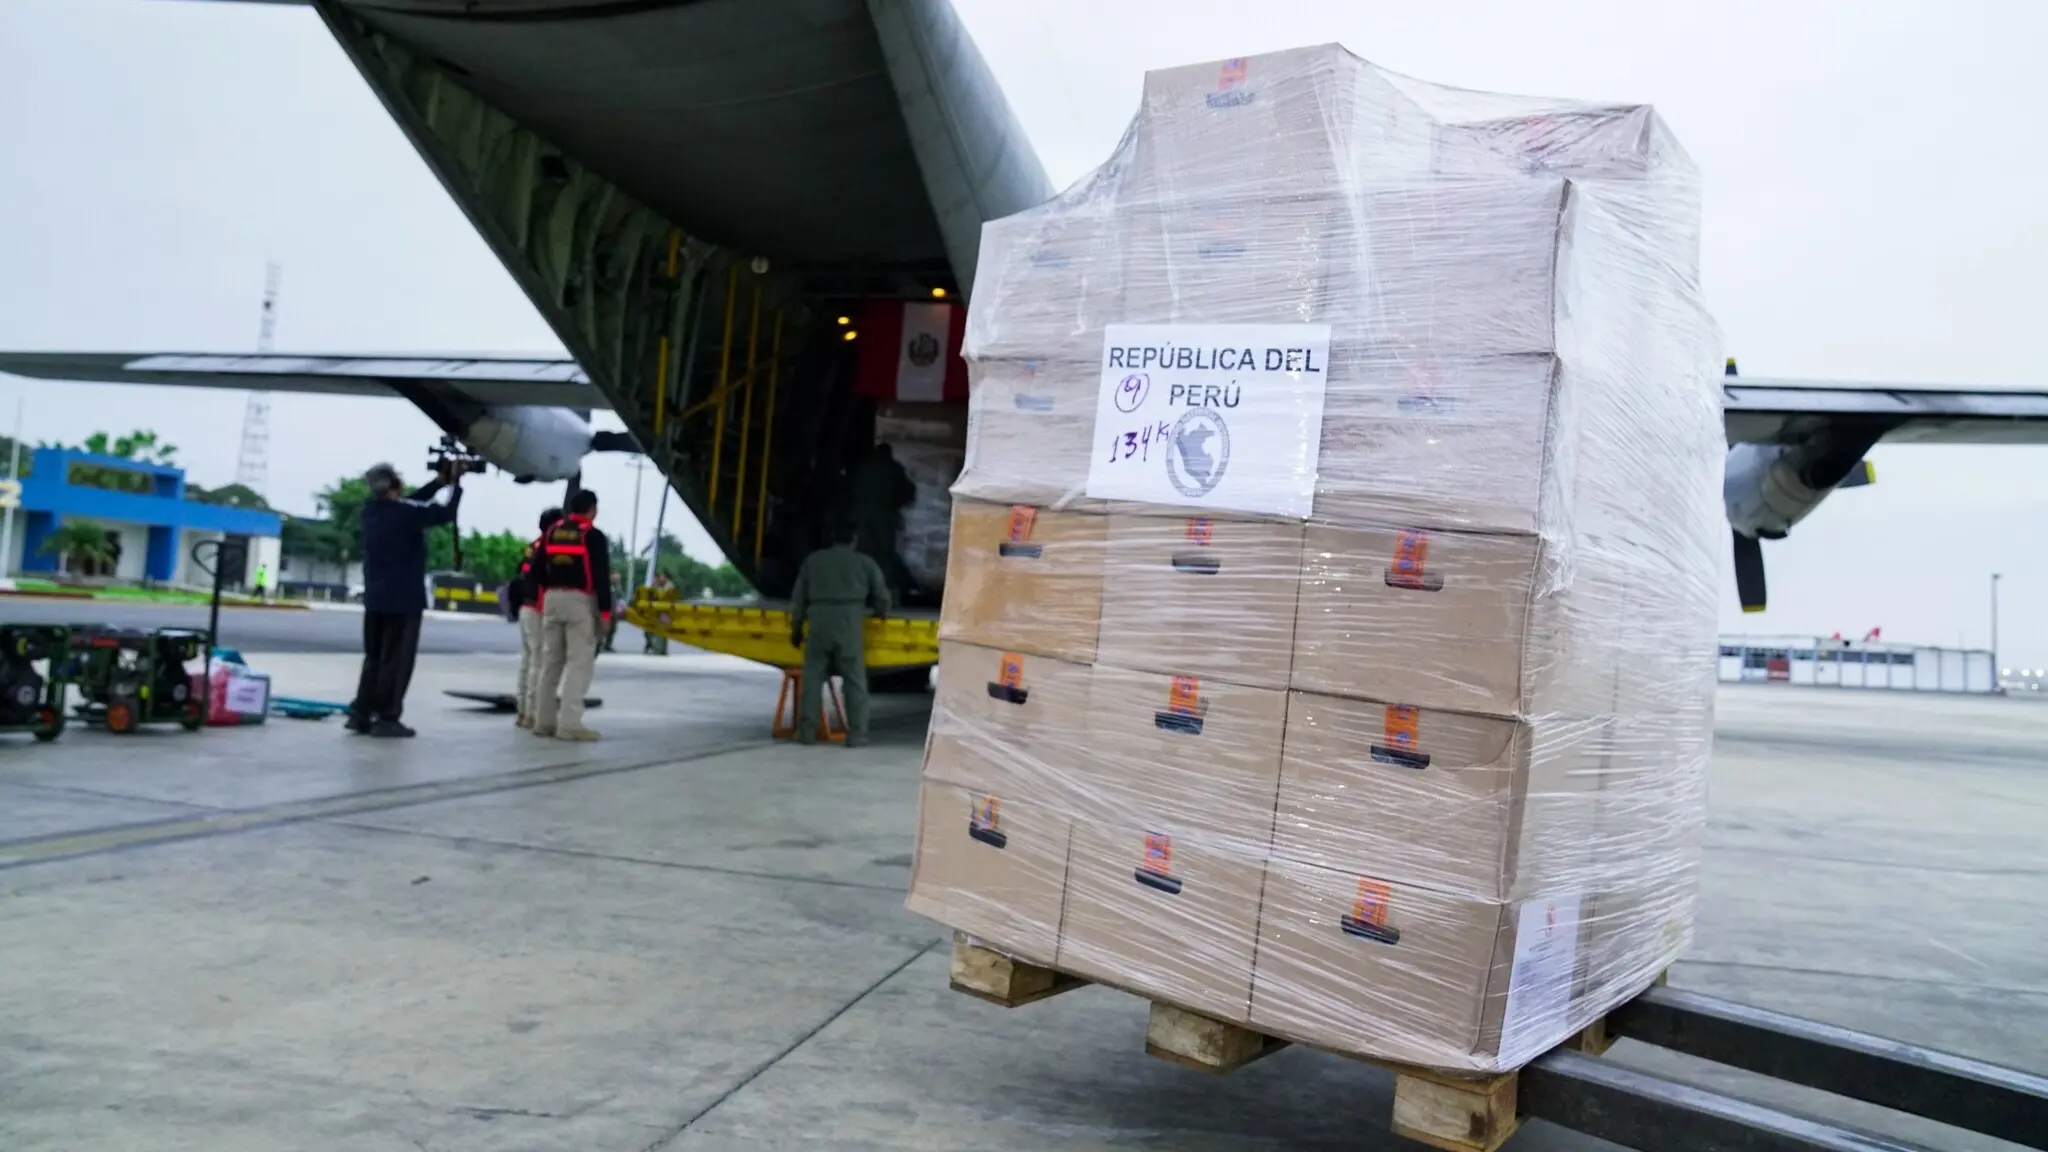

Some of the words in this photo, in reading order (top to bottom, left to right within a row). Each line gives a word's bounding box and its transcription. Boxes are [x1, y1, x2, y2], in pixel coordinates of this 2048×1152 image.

[1108, 341, 1256, 371] REPÚBLICA
[1264, 347, 1321, 373] DEL
[1168, 379, 1241, 409] PERÚ
